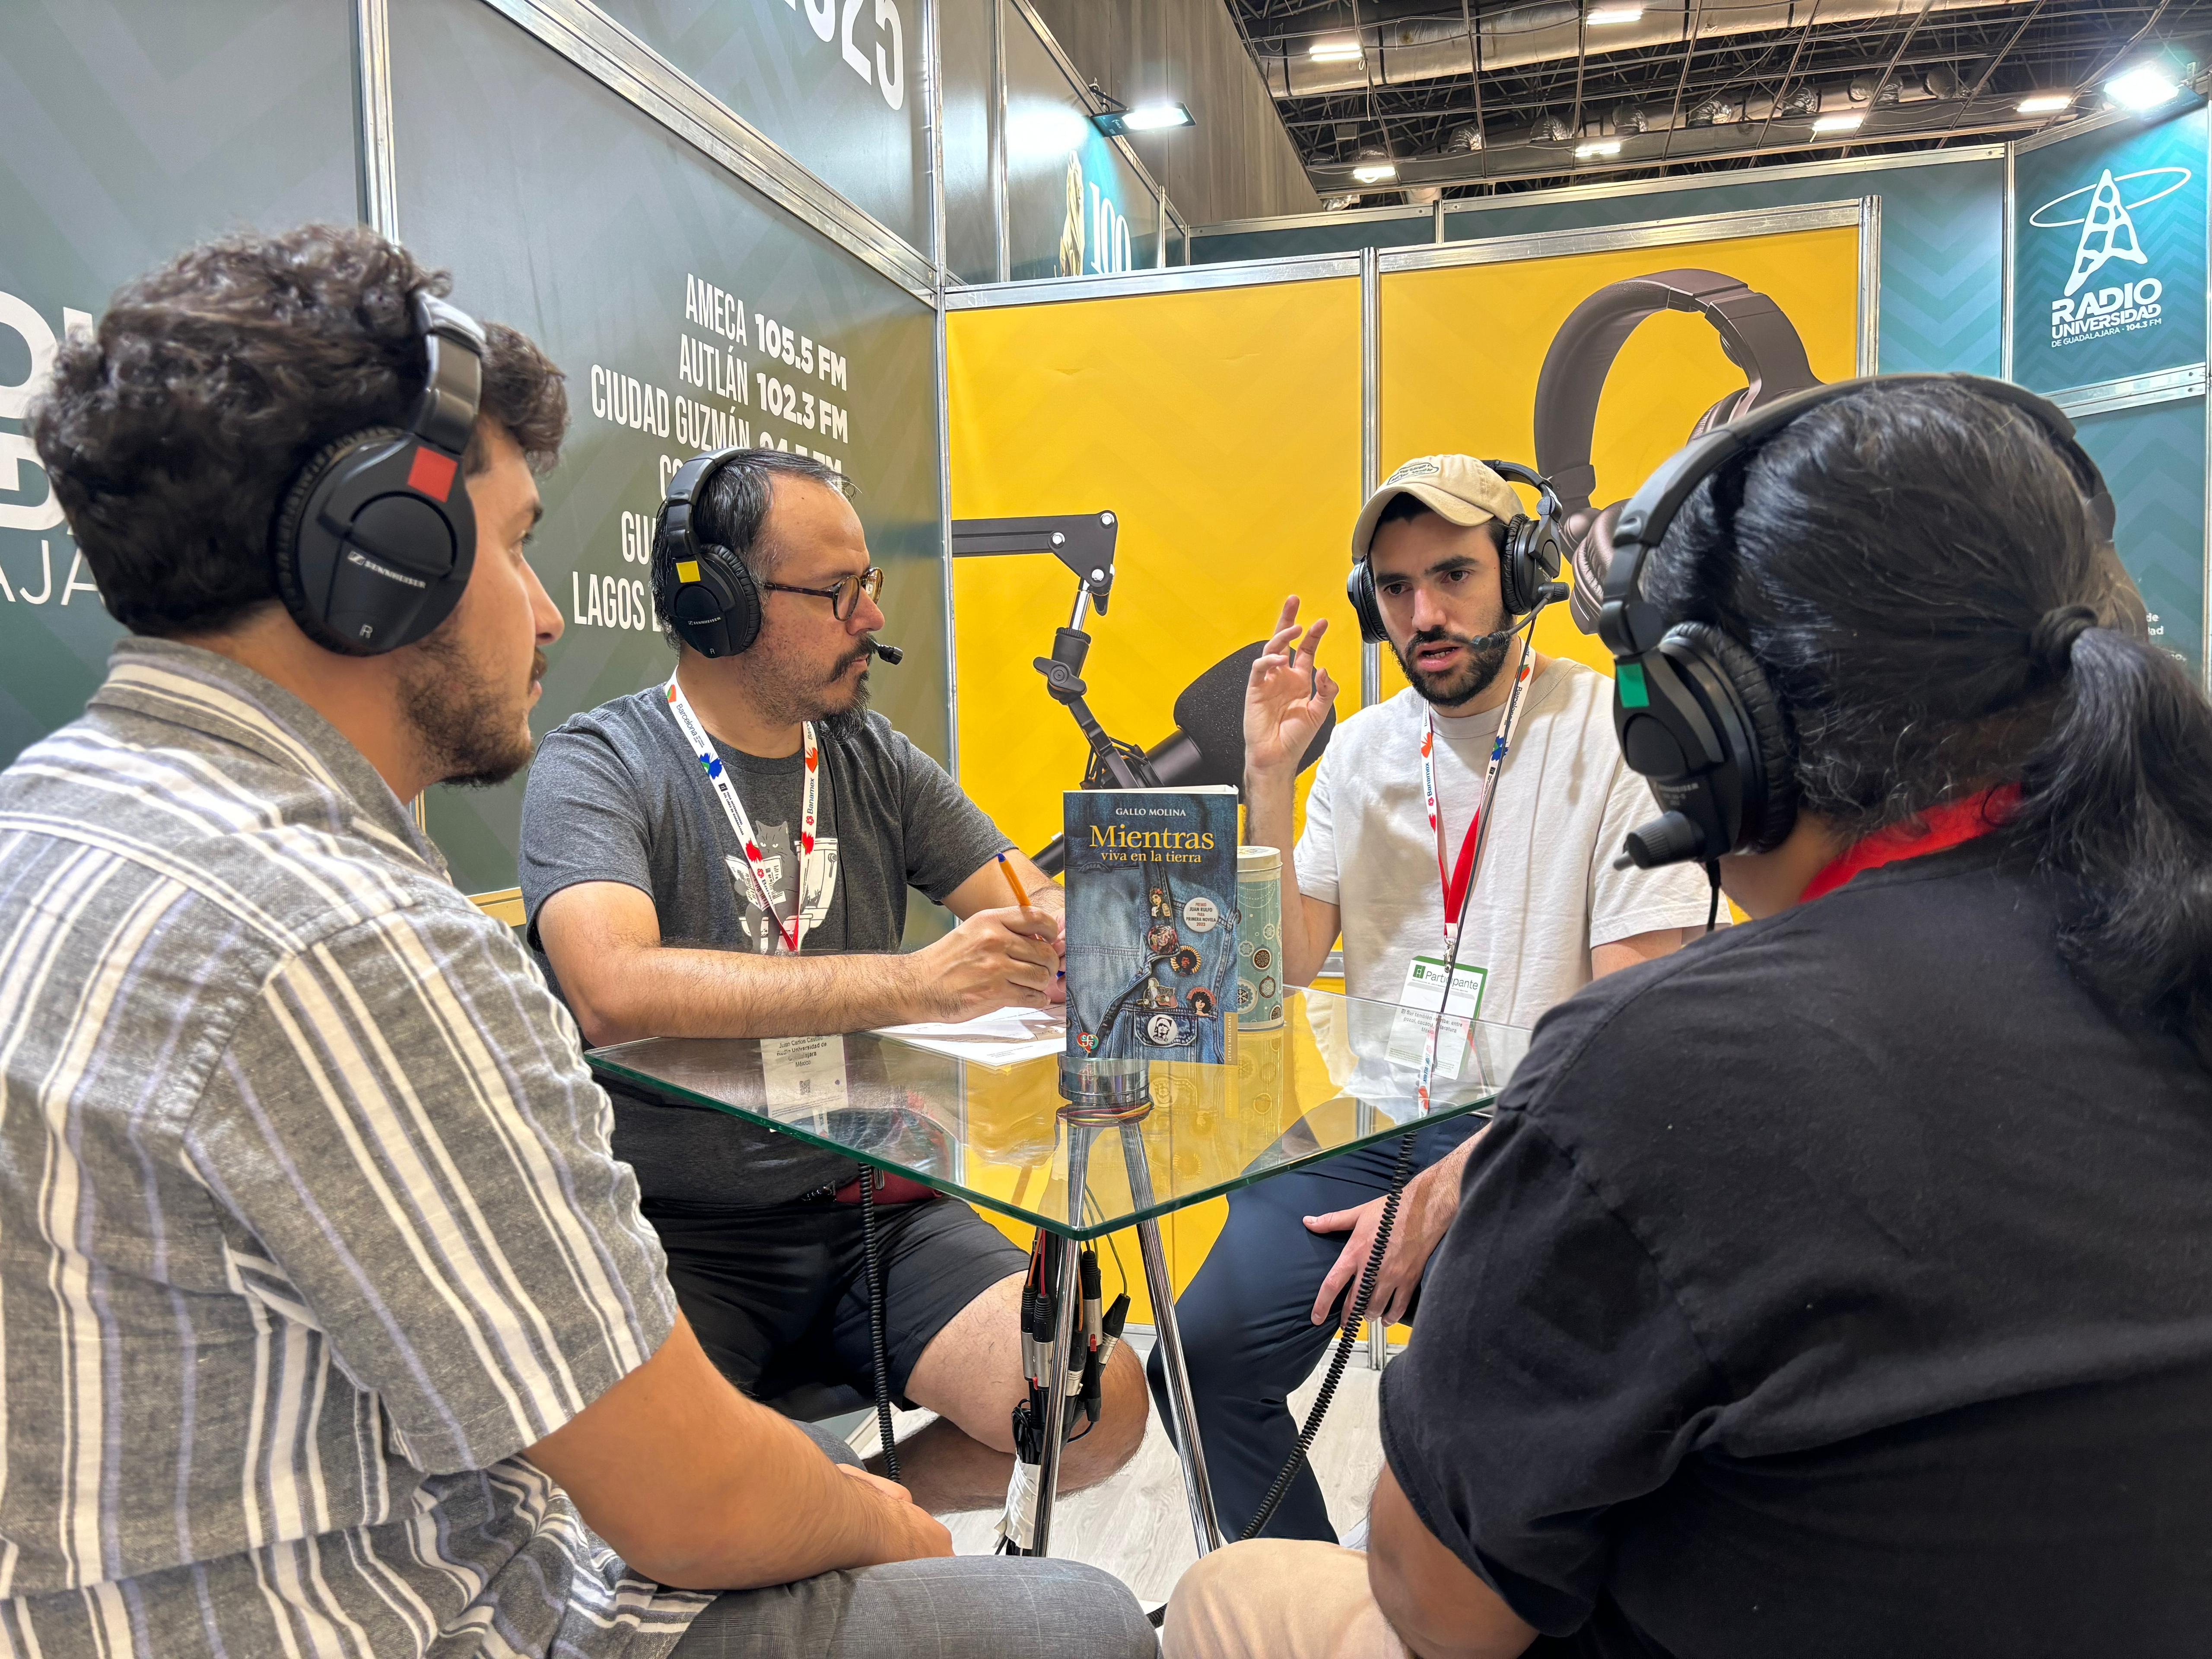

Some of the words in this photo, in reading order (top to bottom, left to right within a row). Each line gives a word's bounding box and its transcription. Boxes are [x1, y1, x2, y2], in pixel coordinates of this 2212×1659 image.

[2052, 278, 2162, 325] RADIO
[686, 273, 747, 346] AMECA
[755, 314, 814, 374] 105.5
[818, 345, 847, 391] FM
[2052, 303, 2161, 339] UNIVERSIDAD
[2052, 340, 2062, 348] DE
[2063, 327, 2120, 345] GUADALAJARA
[2126, 321, 2148, 331] 104.3
[2149, 318, 2162, 326] FM
[591, 365, 669, 438] CIUDAD
[675, 396, 750, 448] GUZMÁN
[680, 334, 749, 405] AUTLÁN
[757, 372, 815, 430] 102.3
[819, 399, 848, 444] FM
[573, 571, 645, 631] LAGOS
[359, 623, 373, 639] R
[676, 703, 697, 736] Barcelona
[1089, 824, 1214, 849] Mientras
[1101, 850, 1127, 861] viva
[1150, 850, 1162, 862] la
[1166, 851, 1201, 863] tierra
